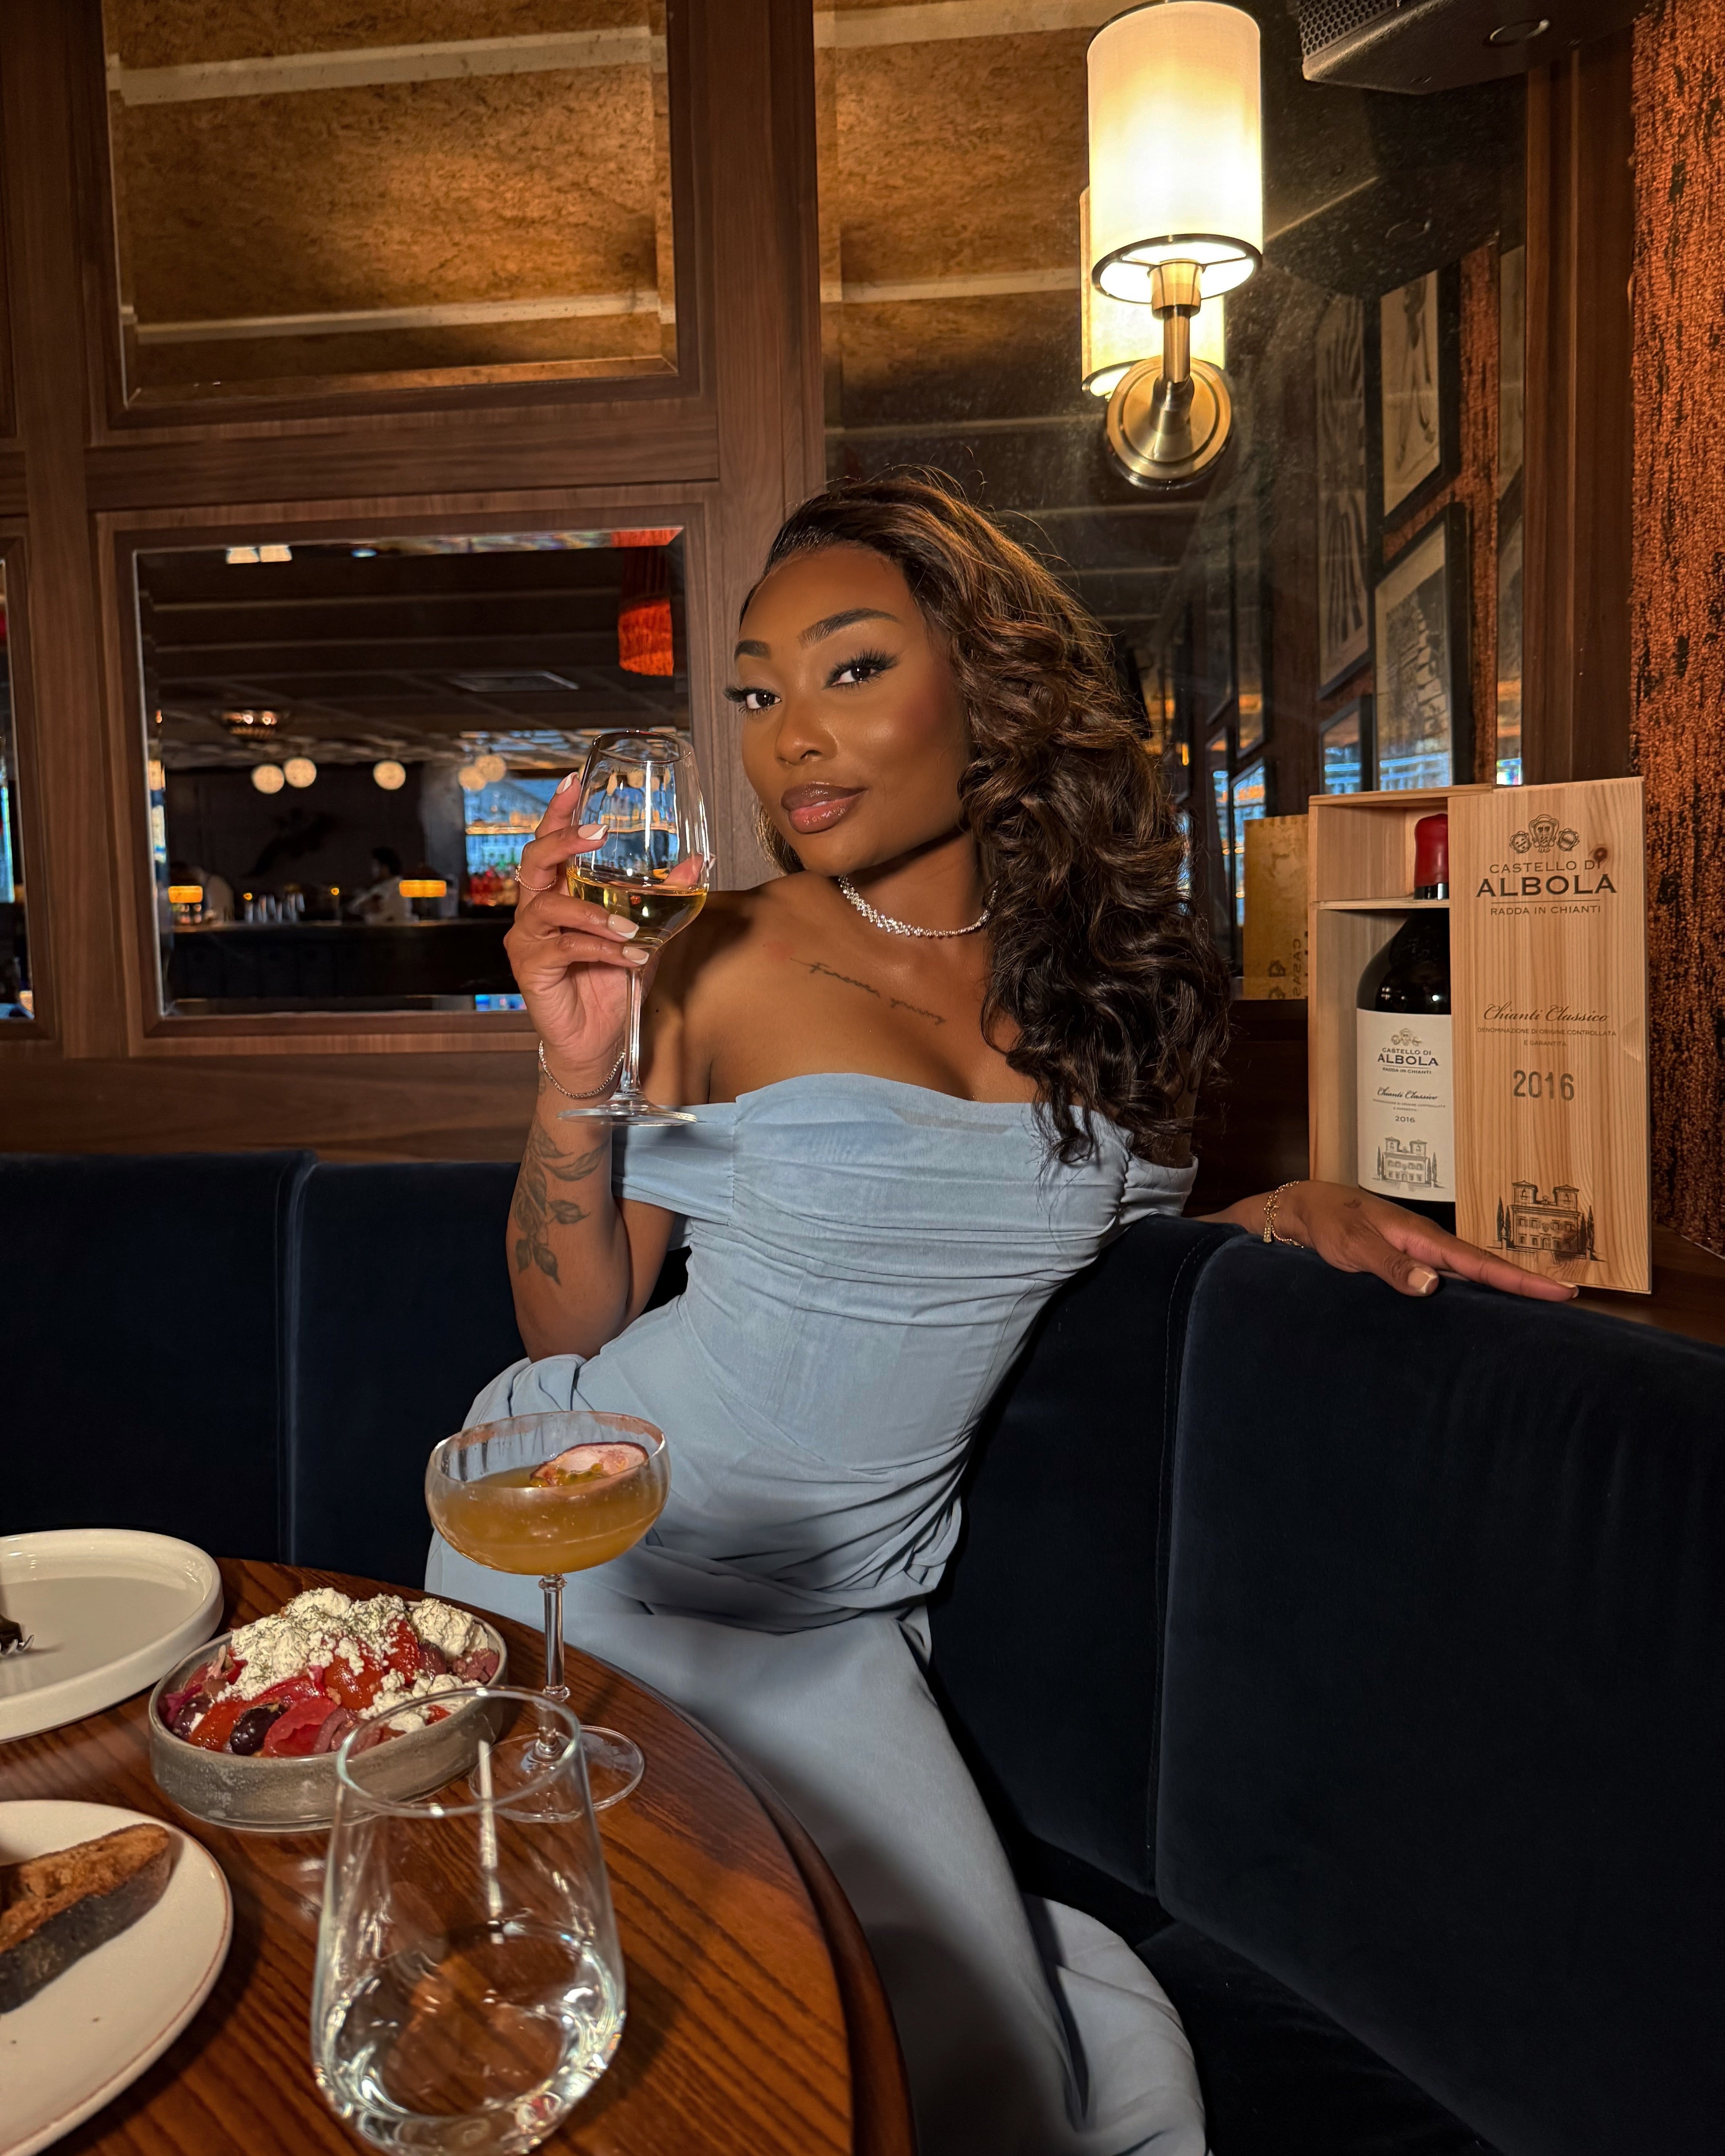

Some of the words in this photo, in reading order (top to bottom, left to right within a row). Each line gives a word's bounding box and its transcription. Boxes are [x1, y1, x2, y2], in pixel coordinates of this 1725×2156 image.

[1489, 860, 1577, 874] CASTELLO
[1584, 860, 1601, 870] DI
[1476, 874, 1617, 898] ALBOLA
[1491, 907, 1529, 916] RADDA
[1551, 905, 1601, 914] CHIANTI
[1484, 1000, 1543, 1022] Chianti
[1545, 1005, 1610, 1022] Classico
[1378, 1053, 1439, 1066] ALBOLA
[1513, 1070, 1574, 1101] 2016
[1378, 1087, 1404, 1098] Chianti
[1405, 1090, 1438, 1100] Classico
